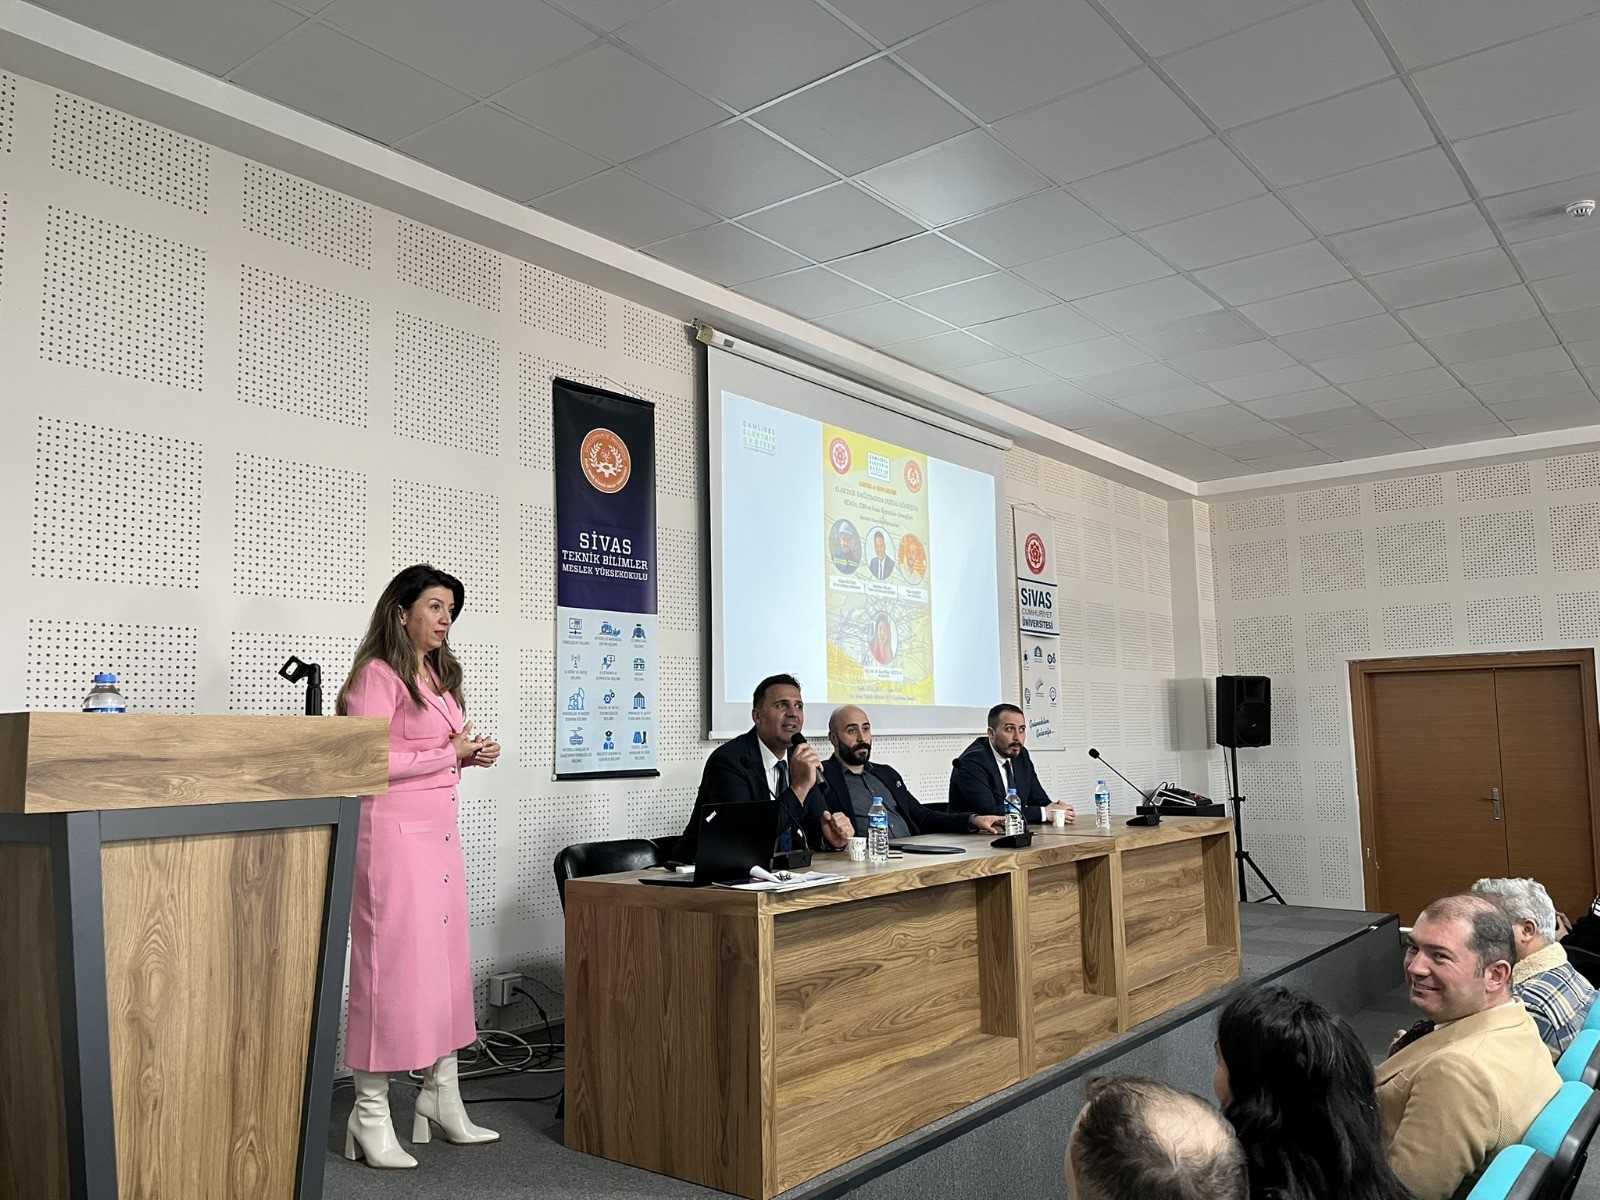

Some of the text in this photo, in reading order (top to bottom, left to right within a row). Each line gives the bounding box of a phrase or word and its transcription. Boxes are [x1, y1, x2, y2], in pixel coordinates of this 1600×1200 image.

[580, 531, 632, 555] SİVAS
[562, 550, 648, 570] TEKNİK BİLİMLER
[562, 563, 648, 581] MESLEK YÜKSEKOKULU
[1022, 617, 1053, 630] ÜNİVERSİTESİ
